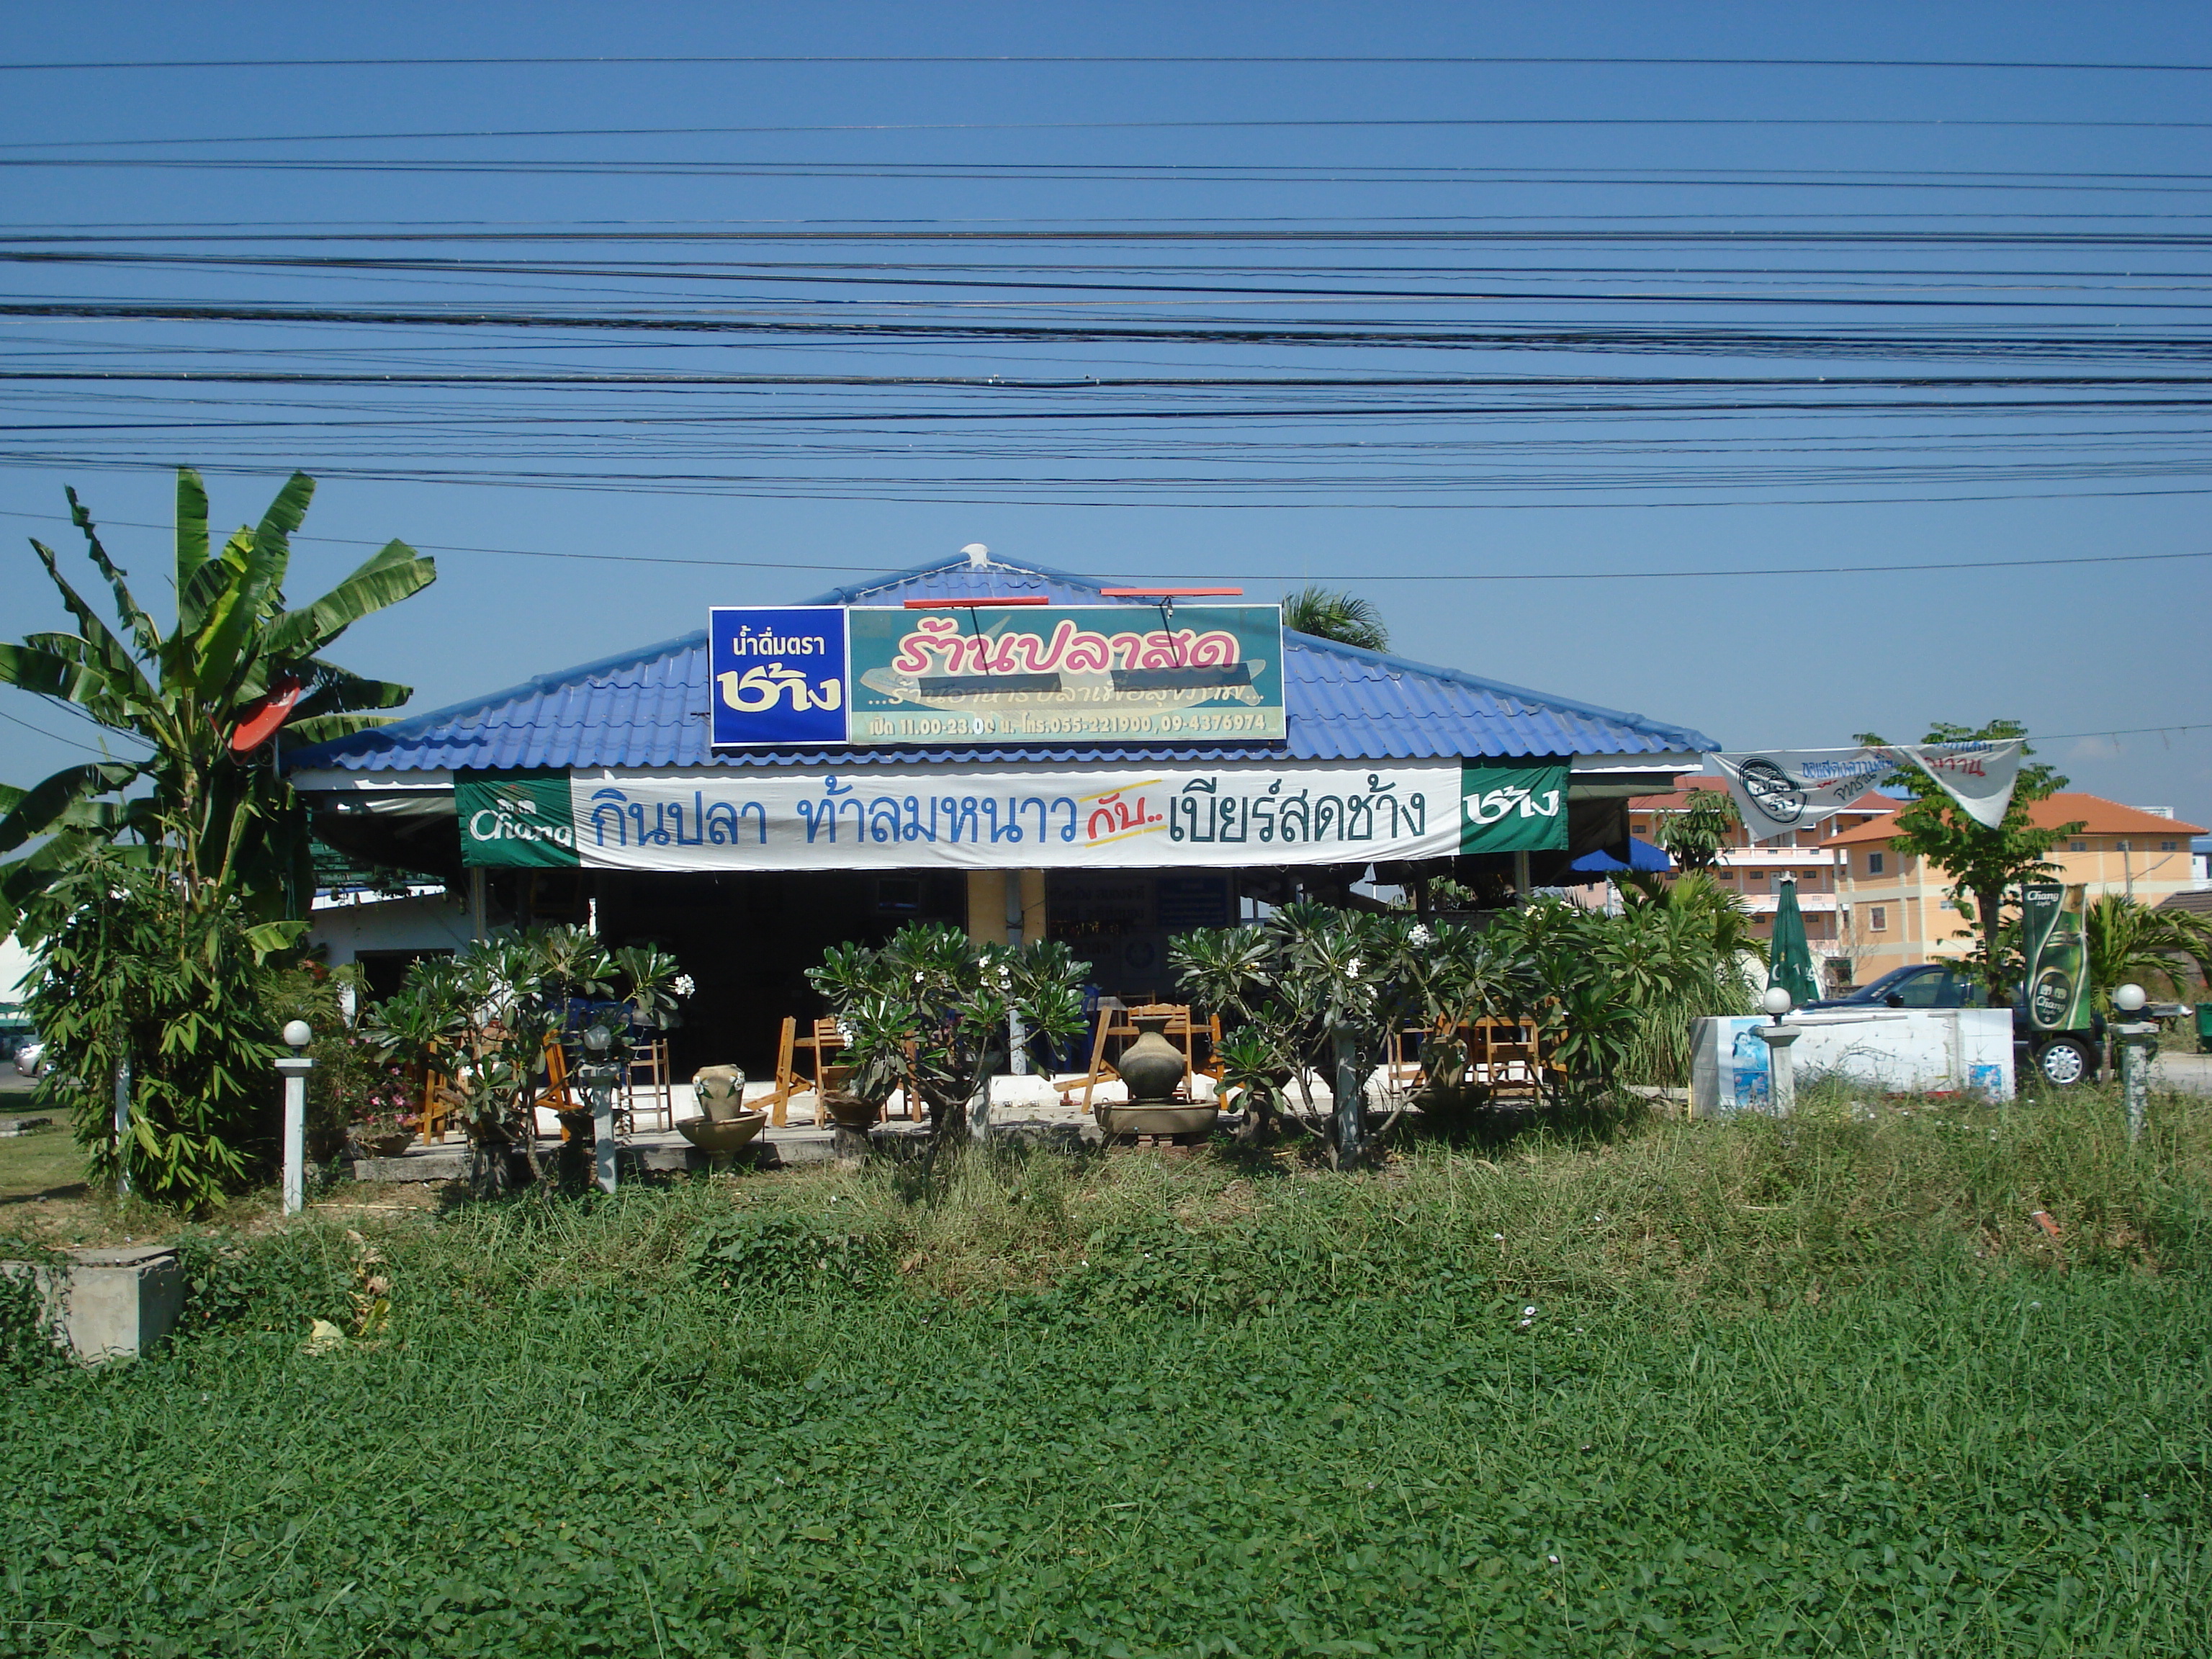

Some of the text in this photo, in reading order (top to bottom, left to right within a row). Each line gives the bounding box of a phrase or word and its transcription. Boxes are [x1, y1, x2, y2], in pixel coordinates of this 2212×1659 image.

[732, 625, 825, 656] น้ำดื่มตรา
[891, 616, 1241, 675] ร้านปลาสด
[716, 662, 842, 713] ช้าง
[870, 717, 894, 736] เปิด
[899, 717, 996, 735] 11.00-23.00
[590, 773, 1426, 848] กินปลา ท้าลมหนาว กับ.. เบียร์สดช้าง
[1462, 785, 1560, 824] ช้าง
[2027, 890, 2060, 902] Chang
